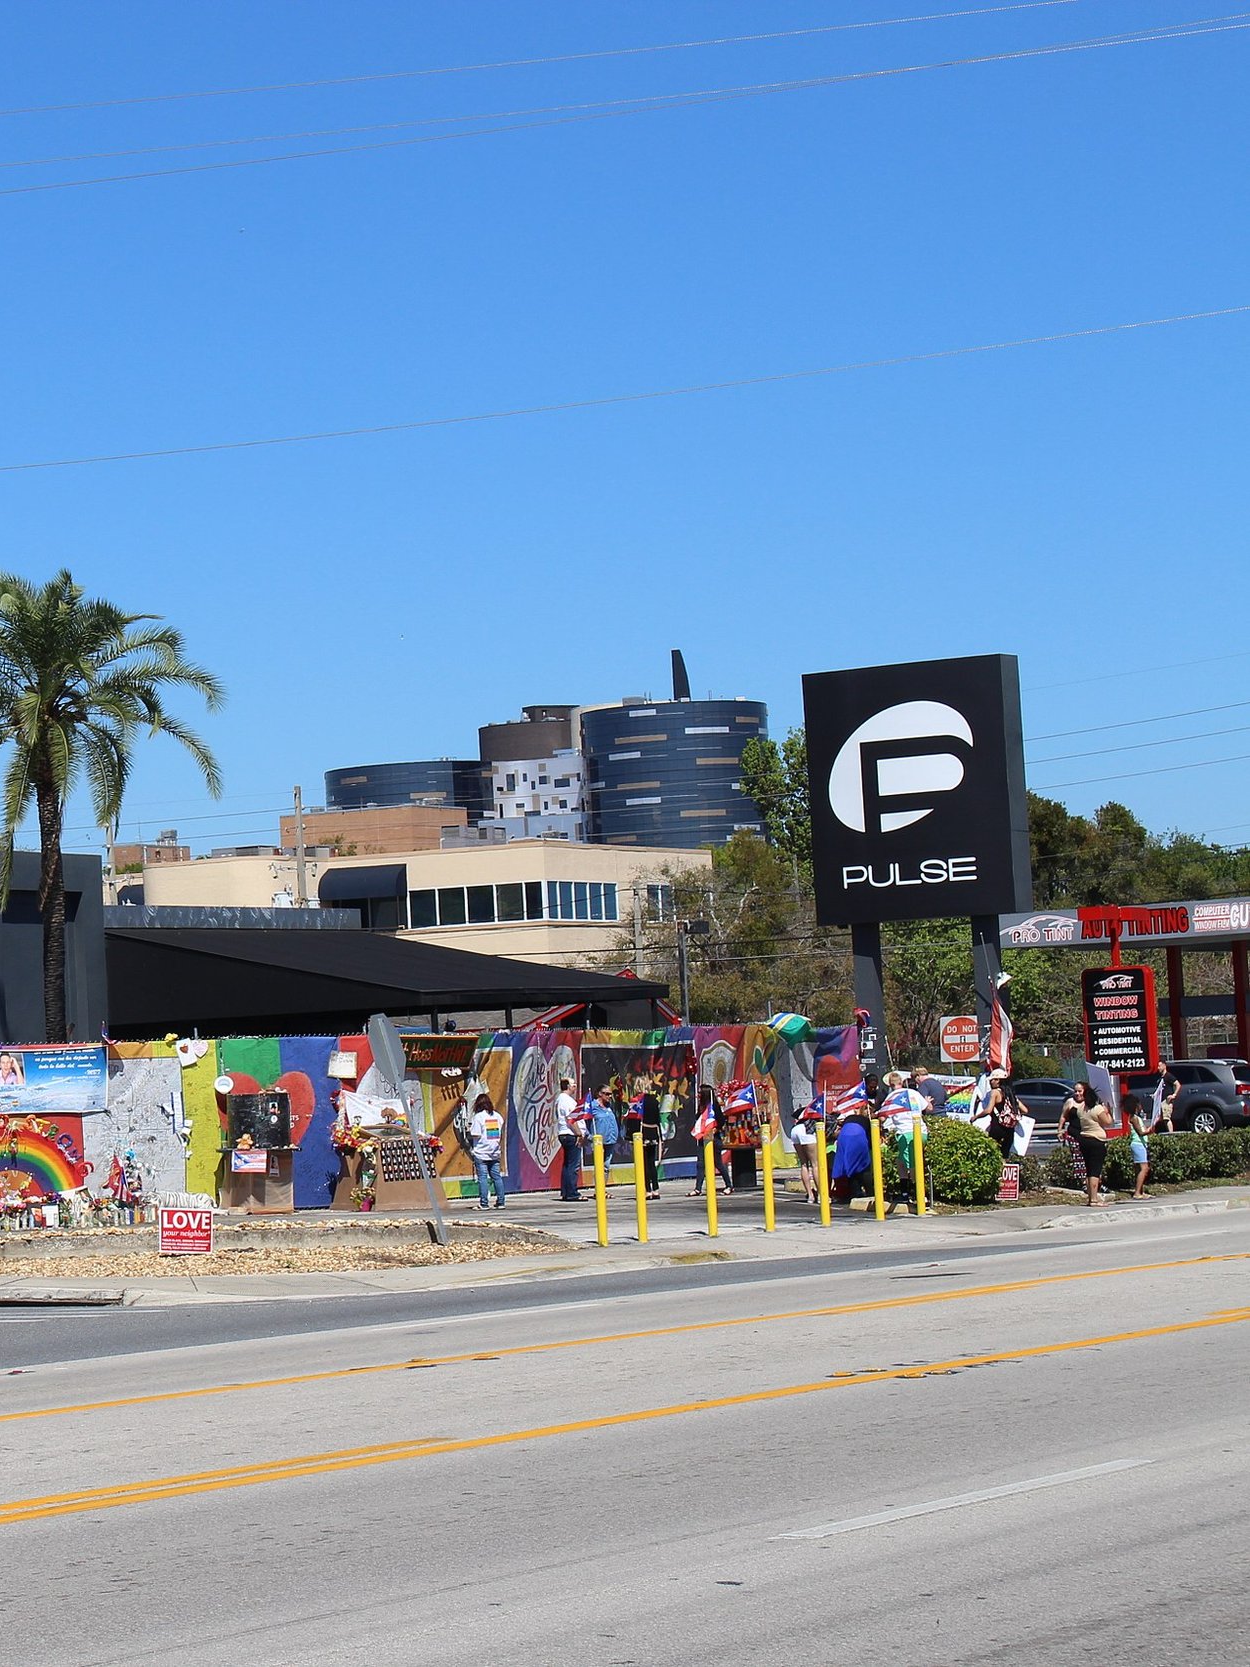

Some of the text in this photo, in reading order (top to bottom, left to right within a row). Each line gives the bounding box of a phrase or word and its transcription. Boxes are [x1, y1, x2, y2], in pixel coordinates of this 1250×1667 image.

[842, 856, 978, 890] PULSE
[1194, 904, 1230, 917] COMPUTER
[1231, 903, 1250, 929] CU
[1011, 926, 1074, 944] PRO TINT
[1093, 995, 1138, 1007] WINDOW
[1094, 1008, 1138, 1020] TINTING
[946, 1024, 977, 1033] DO NOT
[1098, 1026, 1141, 1035] AUTOMOTIVE
[1098, 1036, 1142, 1045] RESIDENTIAL
[950, 1044, 975, 1053] ENTER
[1099, 1046, 1143, 1056] COMMERCIAL
[1096, 1058, 1145, 1069] 407-841-2123
[1002, 1166, 1018, 1181] OVE
[162, 1210, 211, 1230] LOVE
[163, 1230, 180, 1238] your
